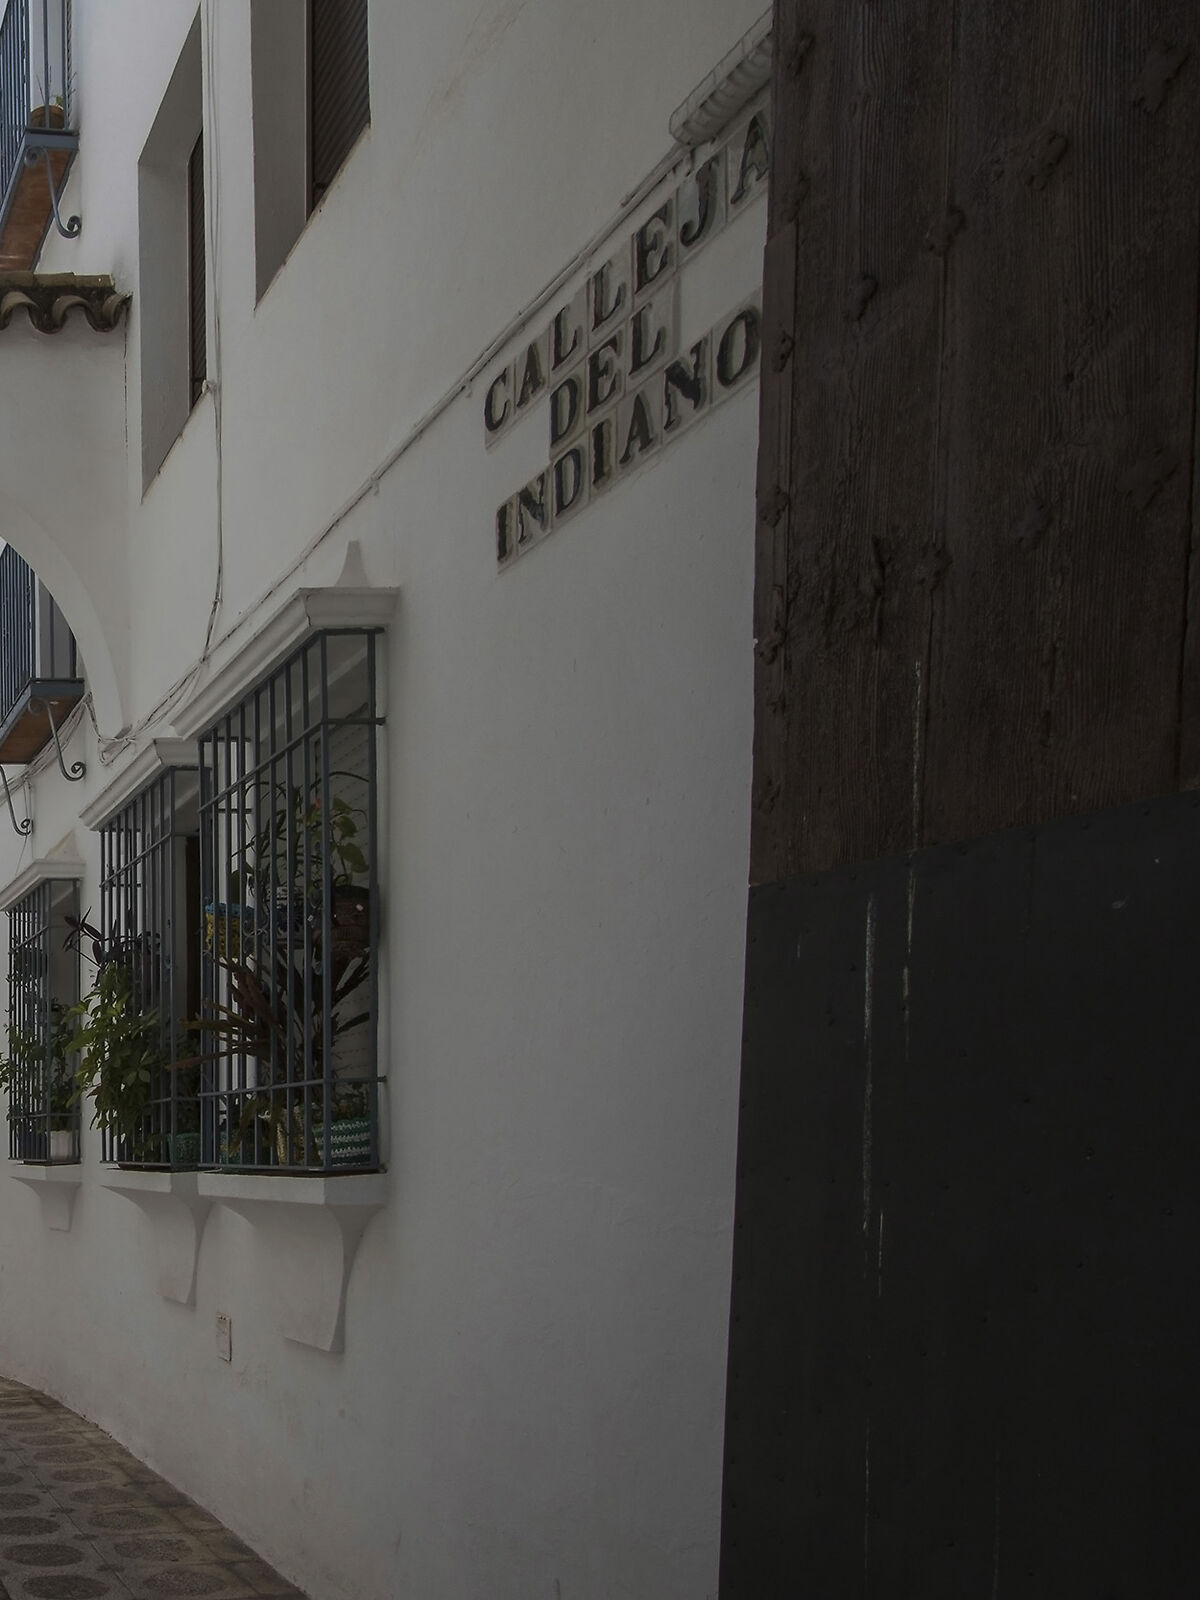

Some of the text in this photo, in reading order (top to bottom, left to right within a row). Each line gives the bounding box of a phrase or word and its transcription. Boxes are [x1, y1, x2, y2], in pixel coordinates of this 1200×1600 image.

[484, 114, 769, 432] CALLEJA
[549, 302, 666, 448] DEL
[497, 305, 762, 562] INDIANO
